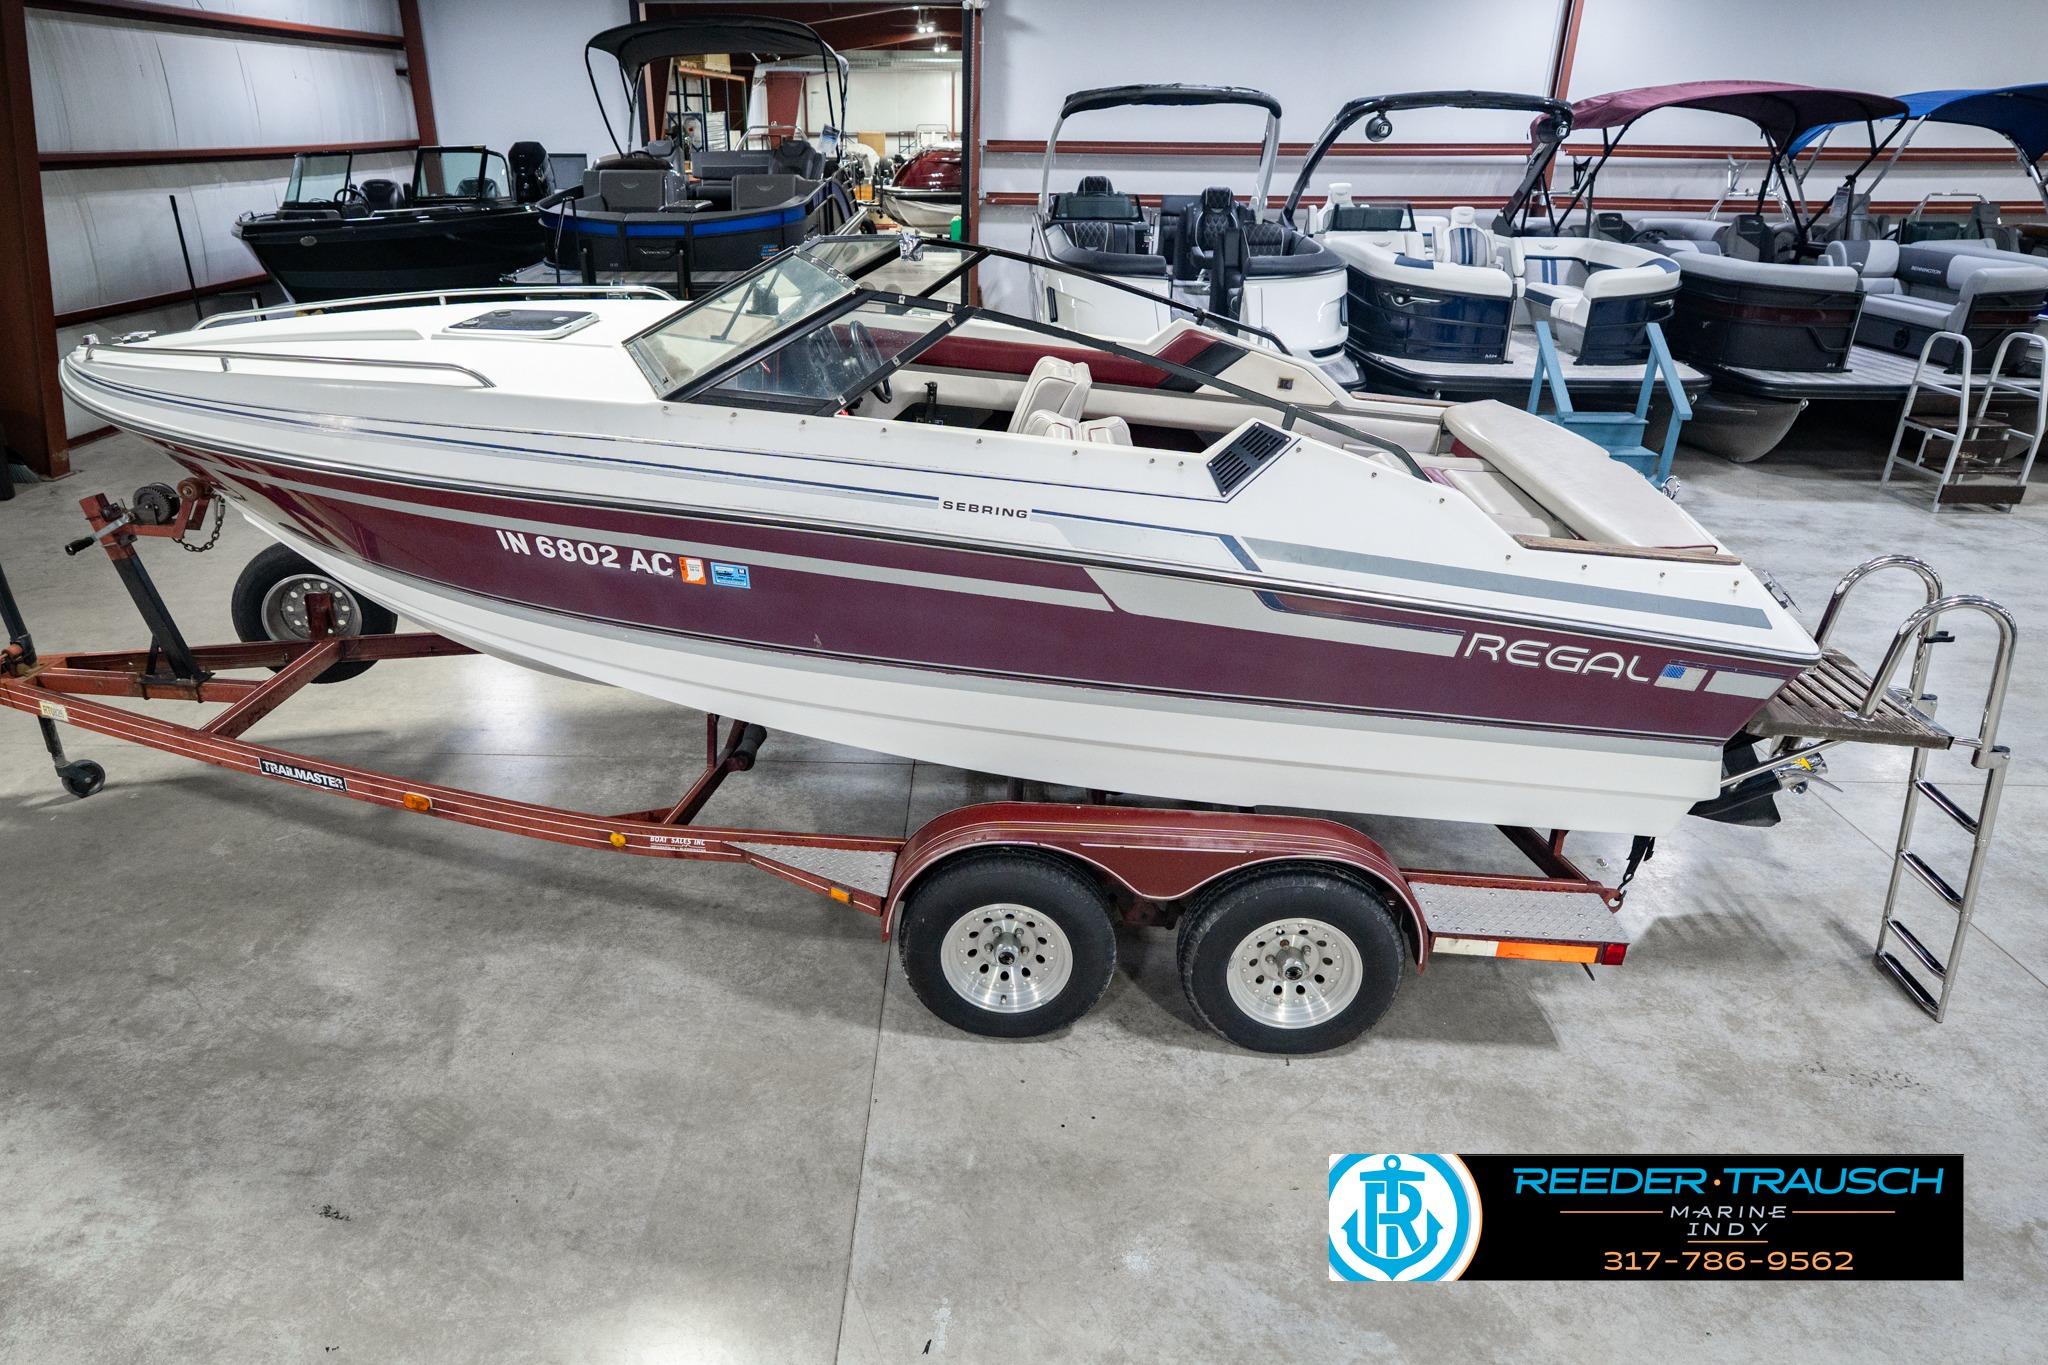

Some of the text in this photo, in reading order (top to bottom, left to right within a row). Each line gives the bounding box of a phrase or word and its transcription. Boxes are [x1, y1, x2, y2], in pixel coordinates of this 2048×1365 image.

[942, 500, 1028, 519] SEBRING
[496, 529, 675, 578] IN 6802 AC
[1463, 632, 1651, 684] REGAL
